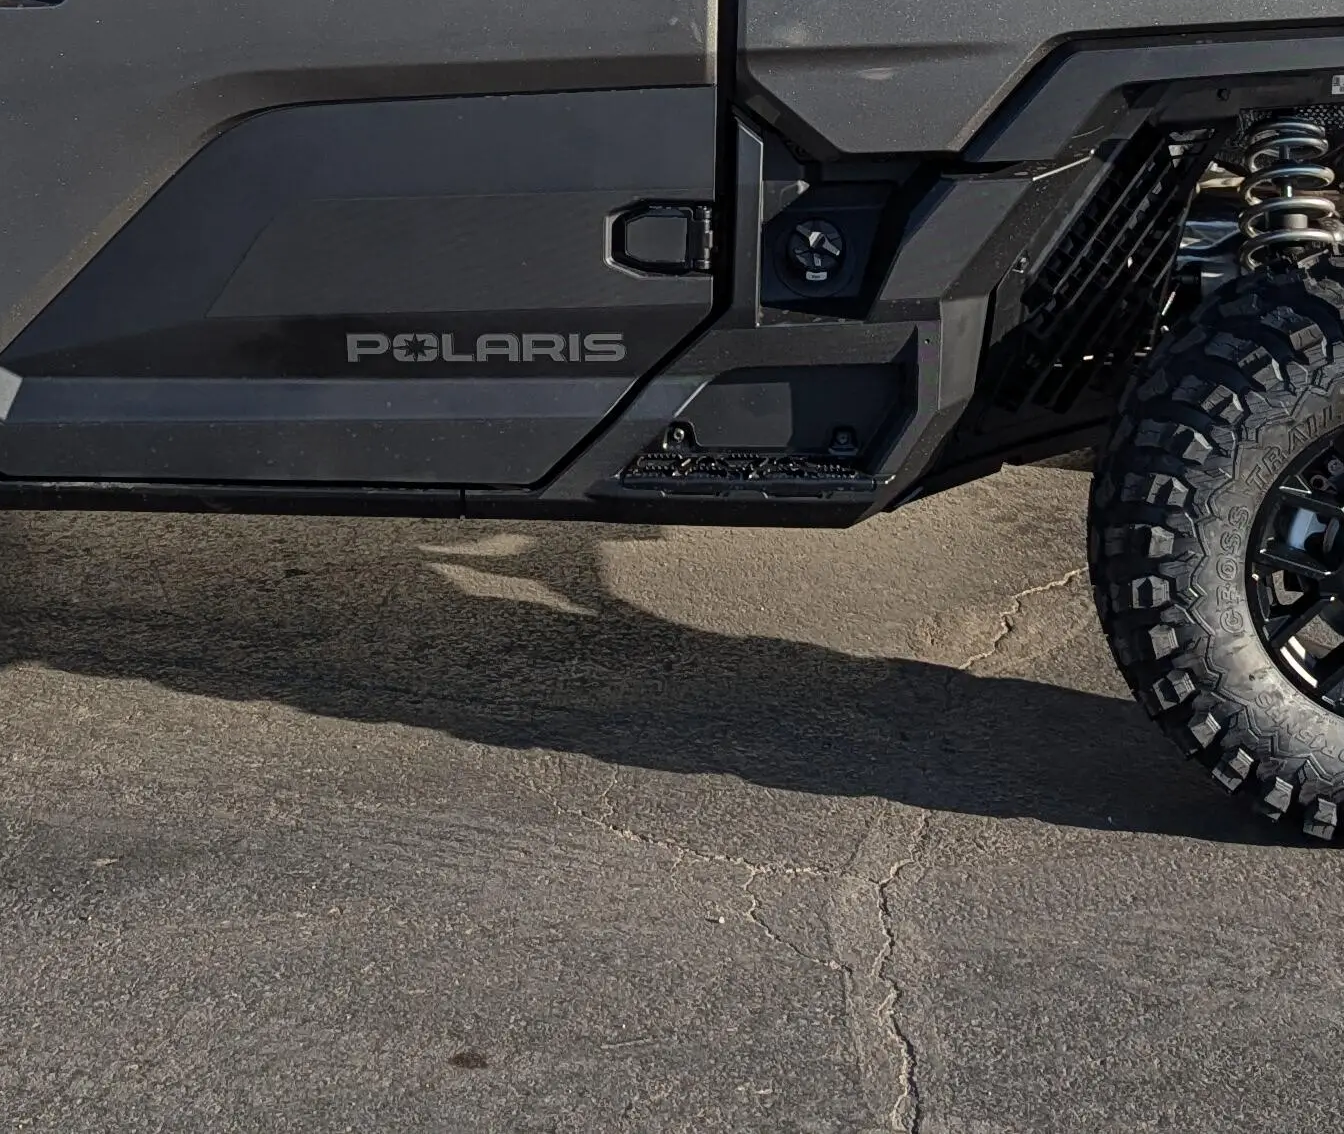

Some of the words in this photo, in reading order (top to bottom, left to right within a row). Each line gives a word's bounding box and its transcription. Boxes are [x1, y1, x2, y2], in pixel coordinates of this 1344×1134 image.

[346, 332, 627, 363] POLARIS
[1215, 506, 1250, 634] CROSS
[1245, 409, 1335, 491] TRAIL
